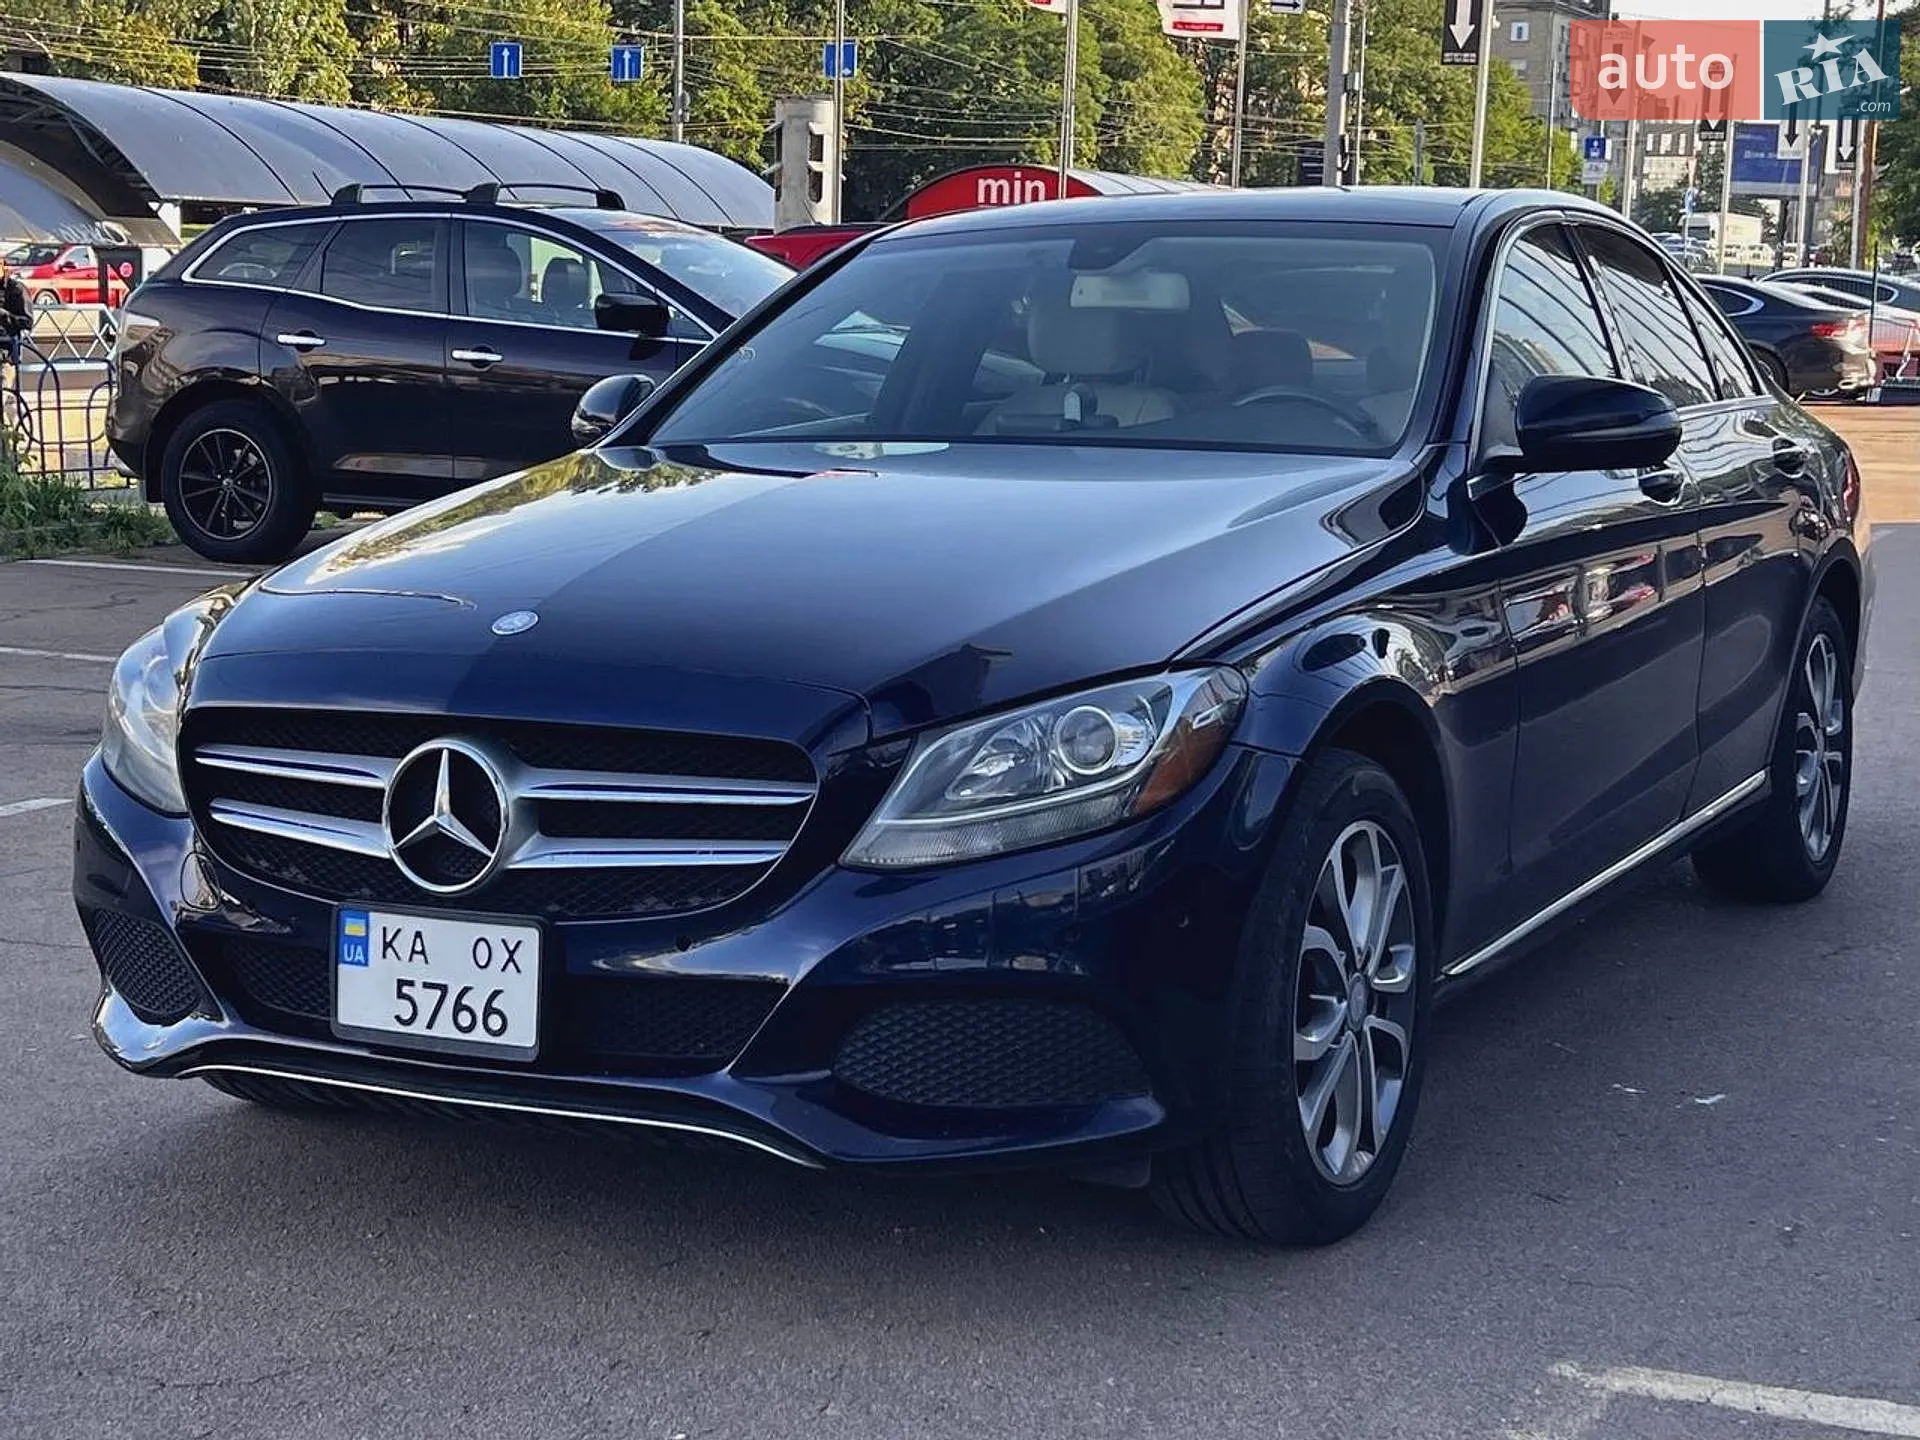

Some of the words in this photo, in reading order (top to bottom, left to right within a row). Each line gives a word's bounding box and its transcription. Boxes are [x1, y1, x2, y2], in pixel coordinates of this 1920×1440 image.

[977, 171, 1046, 204] min
[343, 943, 366, 964] UA
[381, 926, 430, 965] KA
[472, 937, 523, 974] OX
[394, 977, 509, 1037] 5766
